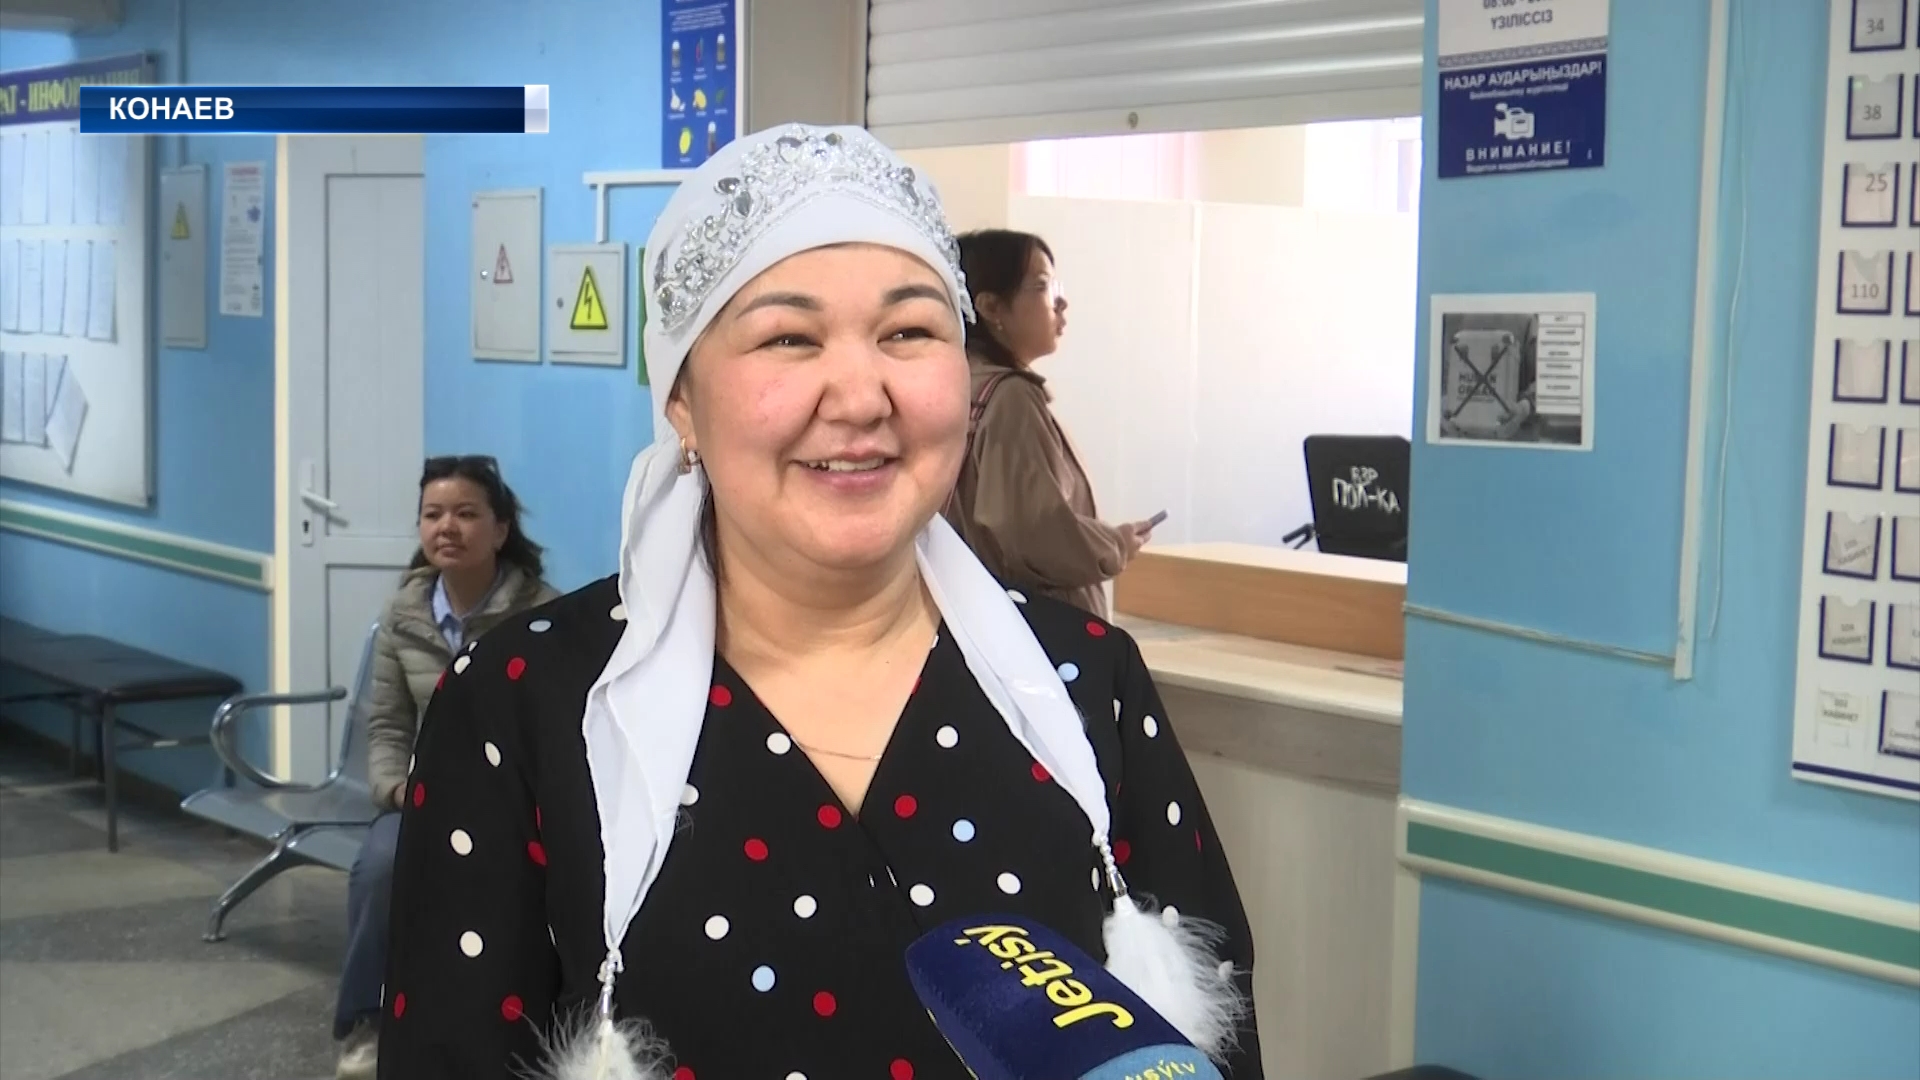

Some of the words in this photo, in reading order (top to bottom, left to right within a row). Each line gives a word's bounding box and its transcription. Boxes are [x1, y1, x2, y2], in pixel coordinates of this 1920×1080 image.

[1866, 18, 1884, 34] 34
[1444, 73, 1486, 91] НАЗАР
[1863, 104, 1882, 121] 38
[1465, 140, 1571, 162] ВНИМАНИЕ!
[1865, 173, 1888, 192] 25
[1852, 283, 1880, 299] 110
[1332, 477, 1401, 514] ПОЛ-КА
[953, 924, 1135, 1028] Jetisý
